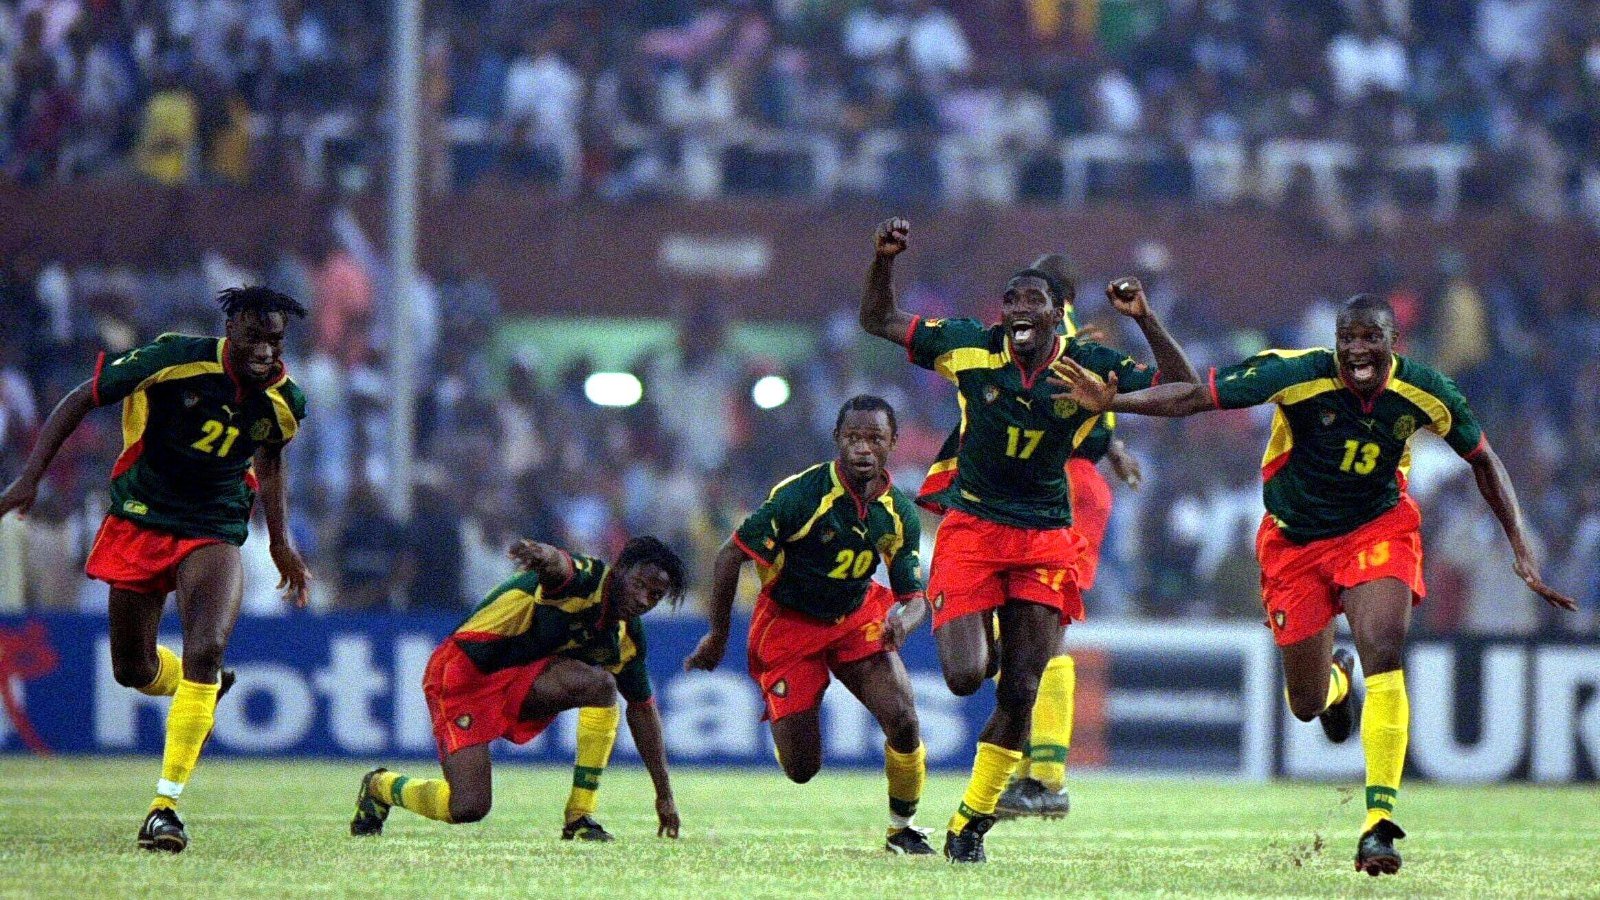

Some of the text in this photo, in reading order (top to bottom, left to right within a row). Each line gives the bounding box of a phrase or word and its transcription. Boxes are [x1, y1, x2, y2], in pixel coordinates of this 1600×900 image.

[191, 420, 239, 457] 21
[1005, 426, 1045, 459] 17
[1340, 440, 1380, 474] 13
[827, 549, 874, 579] 20
[1358, 541, 1390, 570] 13
